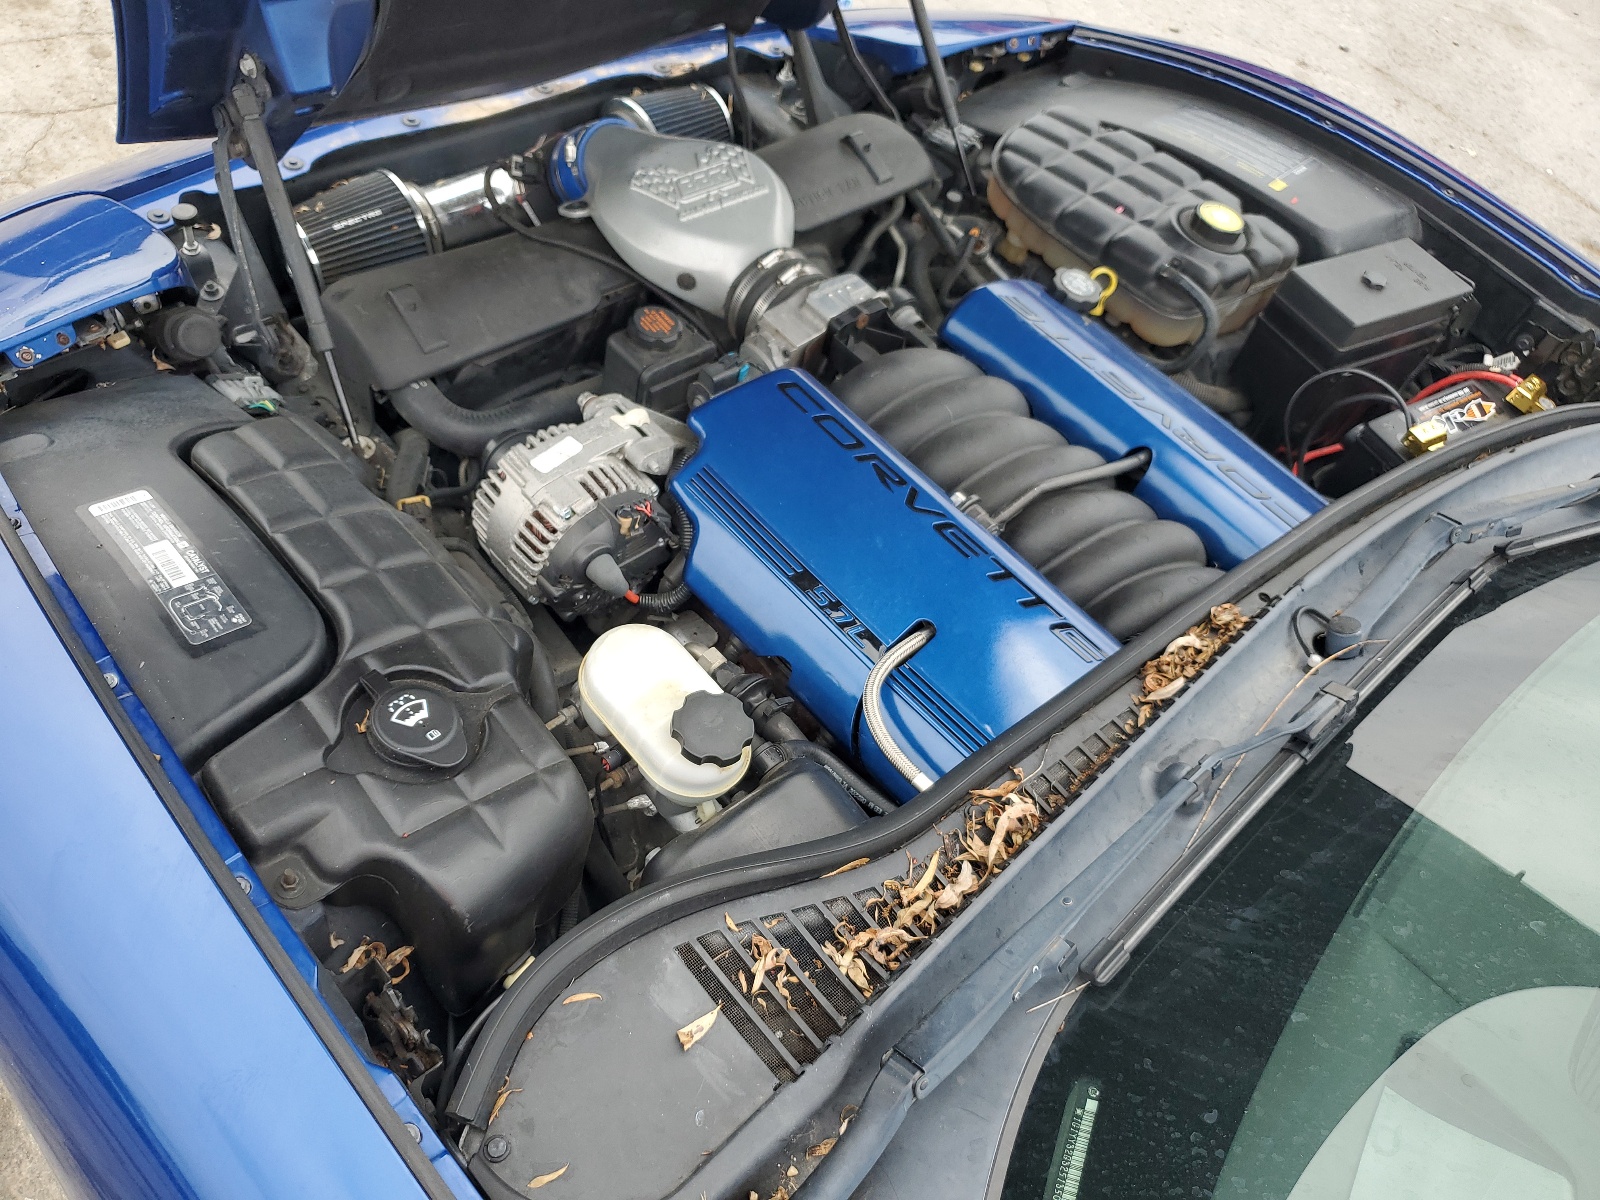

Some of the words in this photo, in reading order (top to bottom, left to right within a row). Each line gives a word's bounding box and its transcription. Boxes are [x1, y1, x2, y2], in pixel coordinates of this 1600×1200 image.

[777, 382, 1109, 663] CORVETTE
[185, 549, 210, 575] CATALYST
[804, 584, 865, 649] 5.7L
